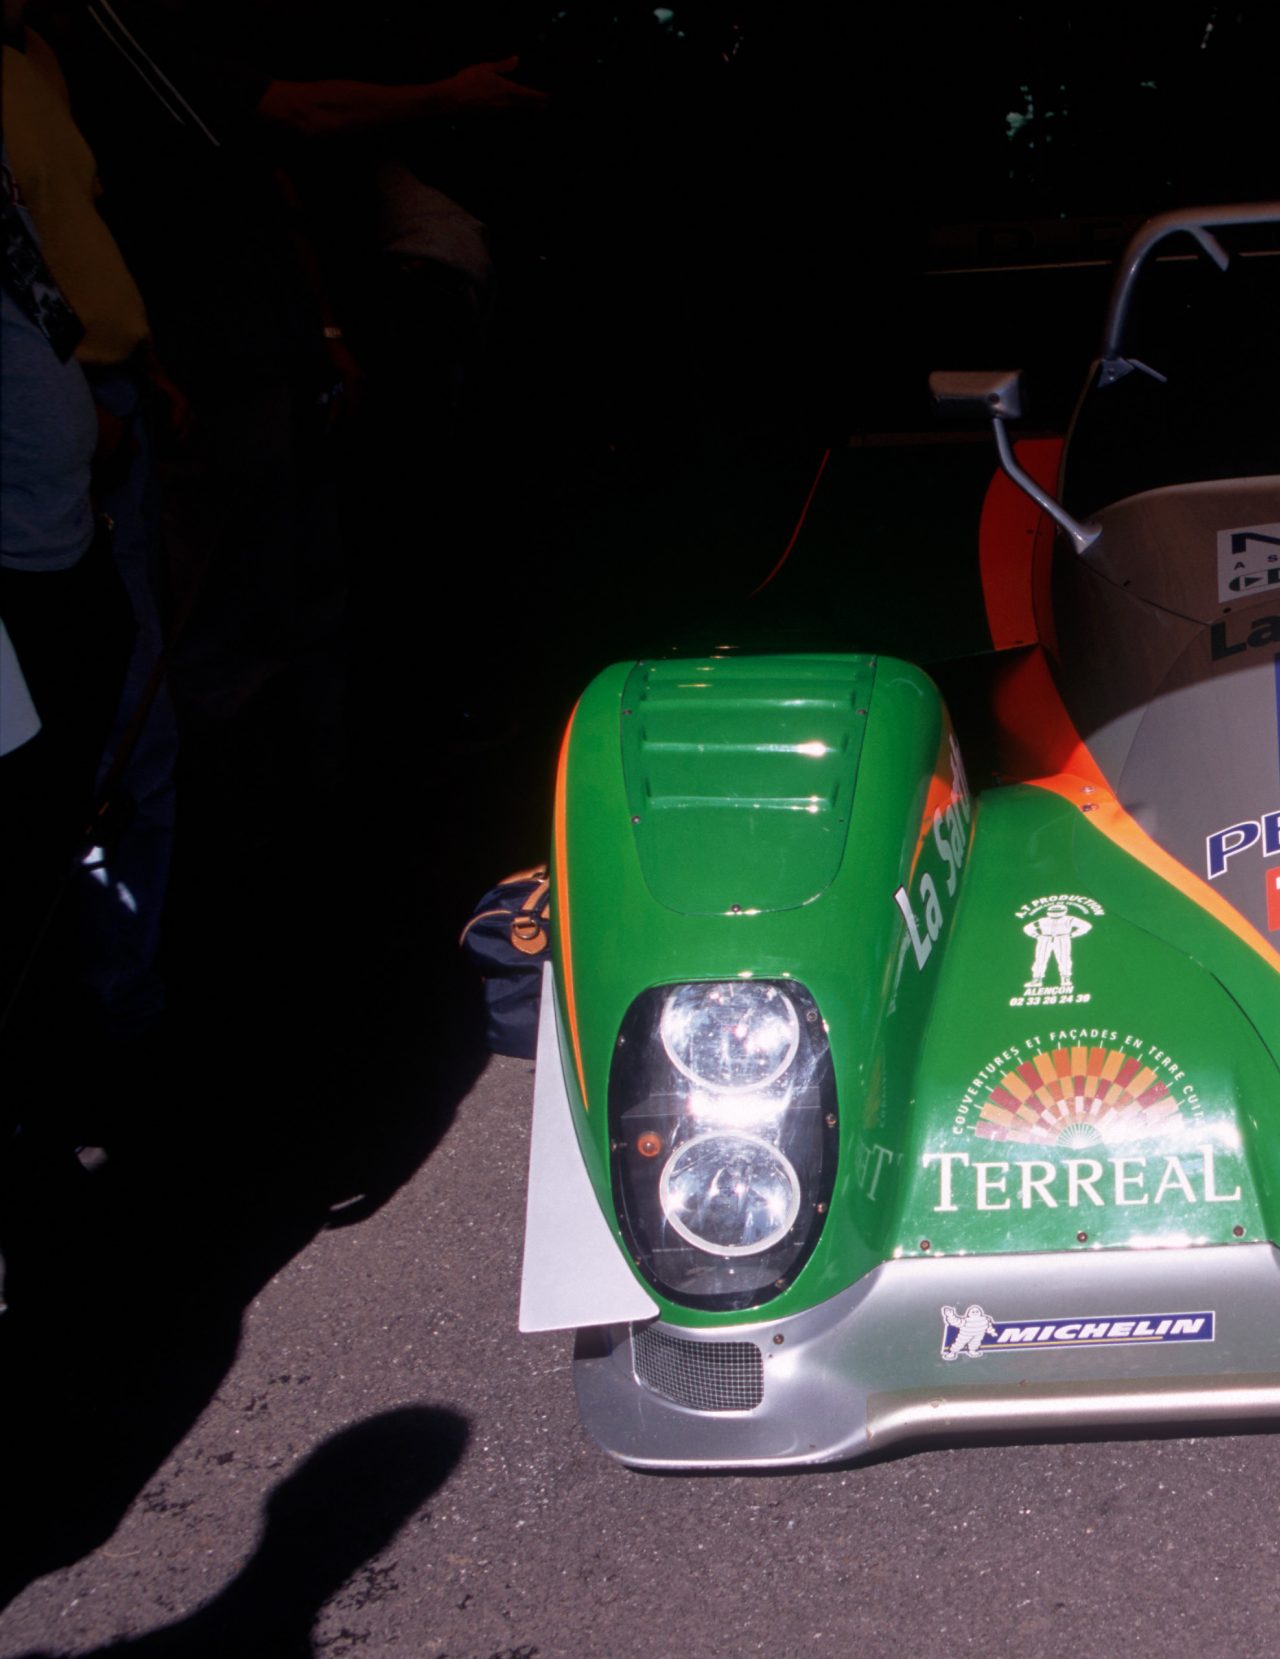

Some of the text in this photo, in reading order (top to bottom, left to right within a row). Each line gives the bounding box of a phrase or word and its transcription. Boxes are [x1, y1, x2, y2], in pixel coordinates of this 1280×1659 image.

[893, 884, 943, 971] La
[1031, 895, 1105, 916] PRODUCTION
[952, 1046, 1019, 1135] COUVERTURES
[1025, 1036, 1041, 1049] ET
[1124, 1035, 1143, 1049] EN
[1148, 1045, 1185, 1081] TERRE
[1183, 1085, 1204, 1121] CUIT
[922, 1144, 1242, 1212] TERREAL
[996, 1317, 1206, 1343] MICHELIN
